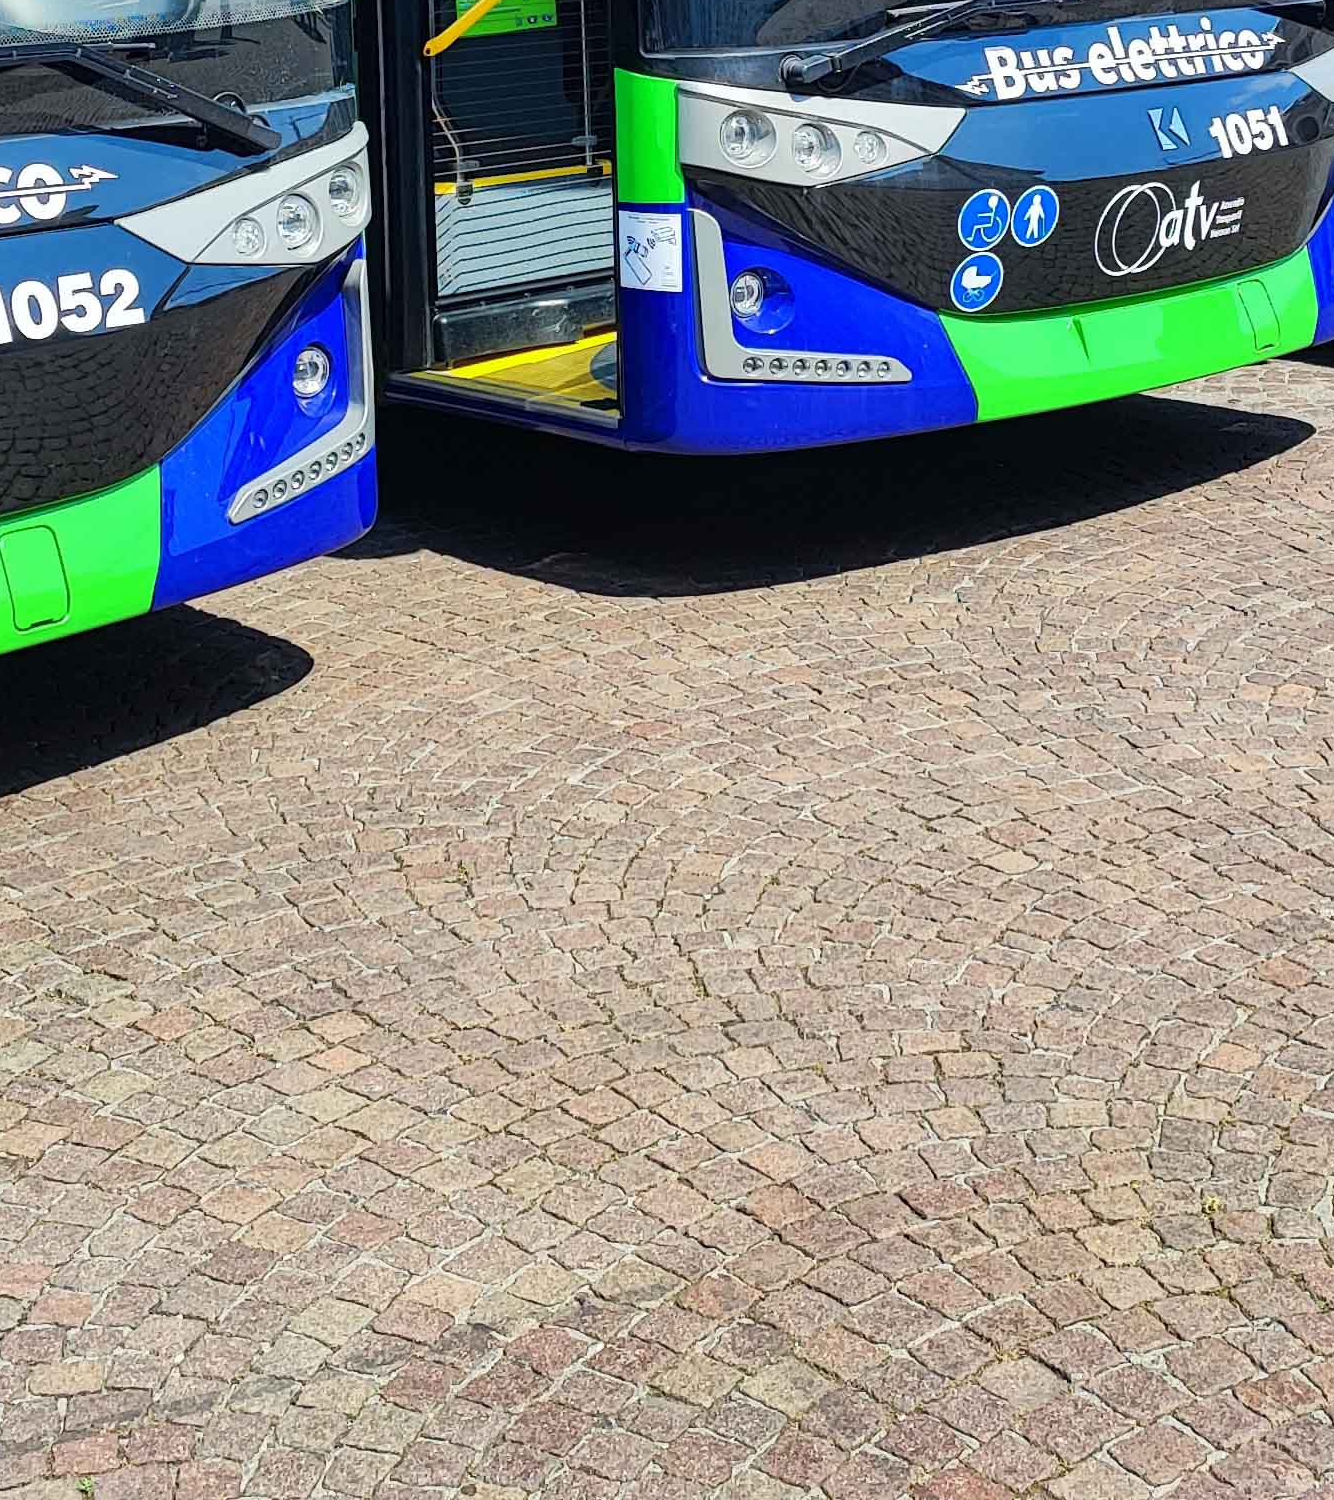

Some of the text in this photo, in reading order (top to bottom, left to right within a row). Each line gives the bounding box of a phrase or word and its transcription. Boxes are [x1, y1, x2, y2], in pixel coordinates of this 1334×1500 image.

[985, 15, 1265, 100] Bus elettrico
[1208, 105, 1290, 159] 1051
[1158, 179, 1220, 251] atv
